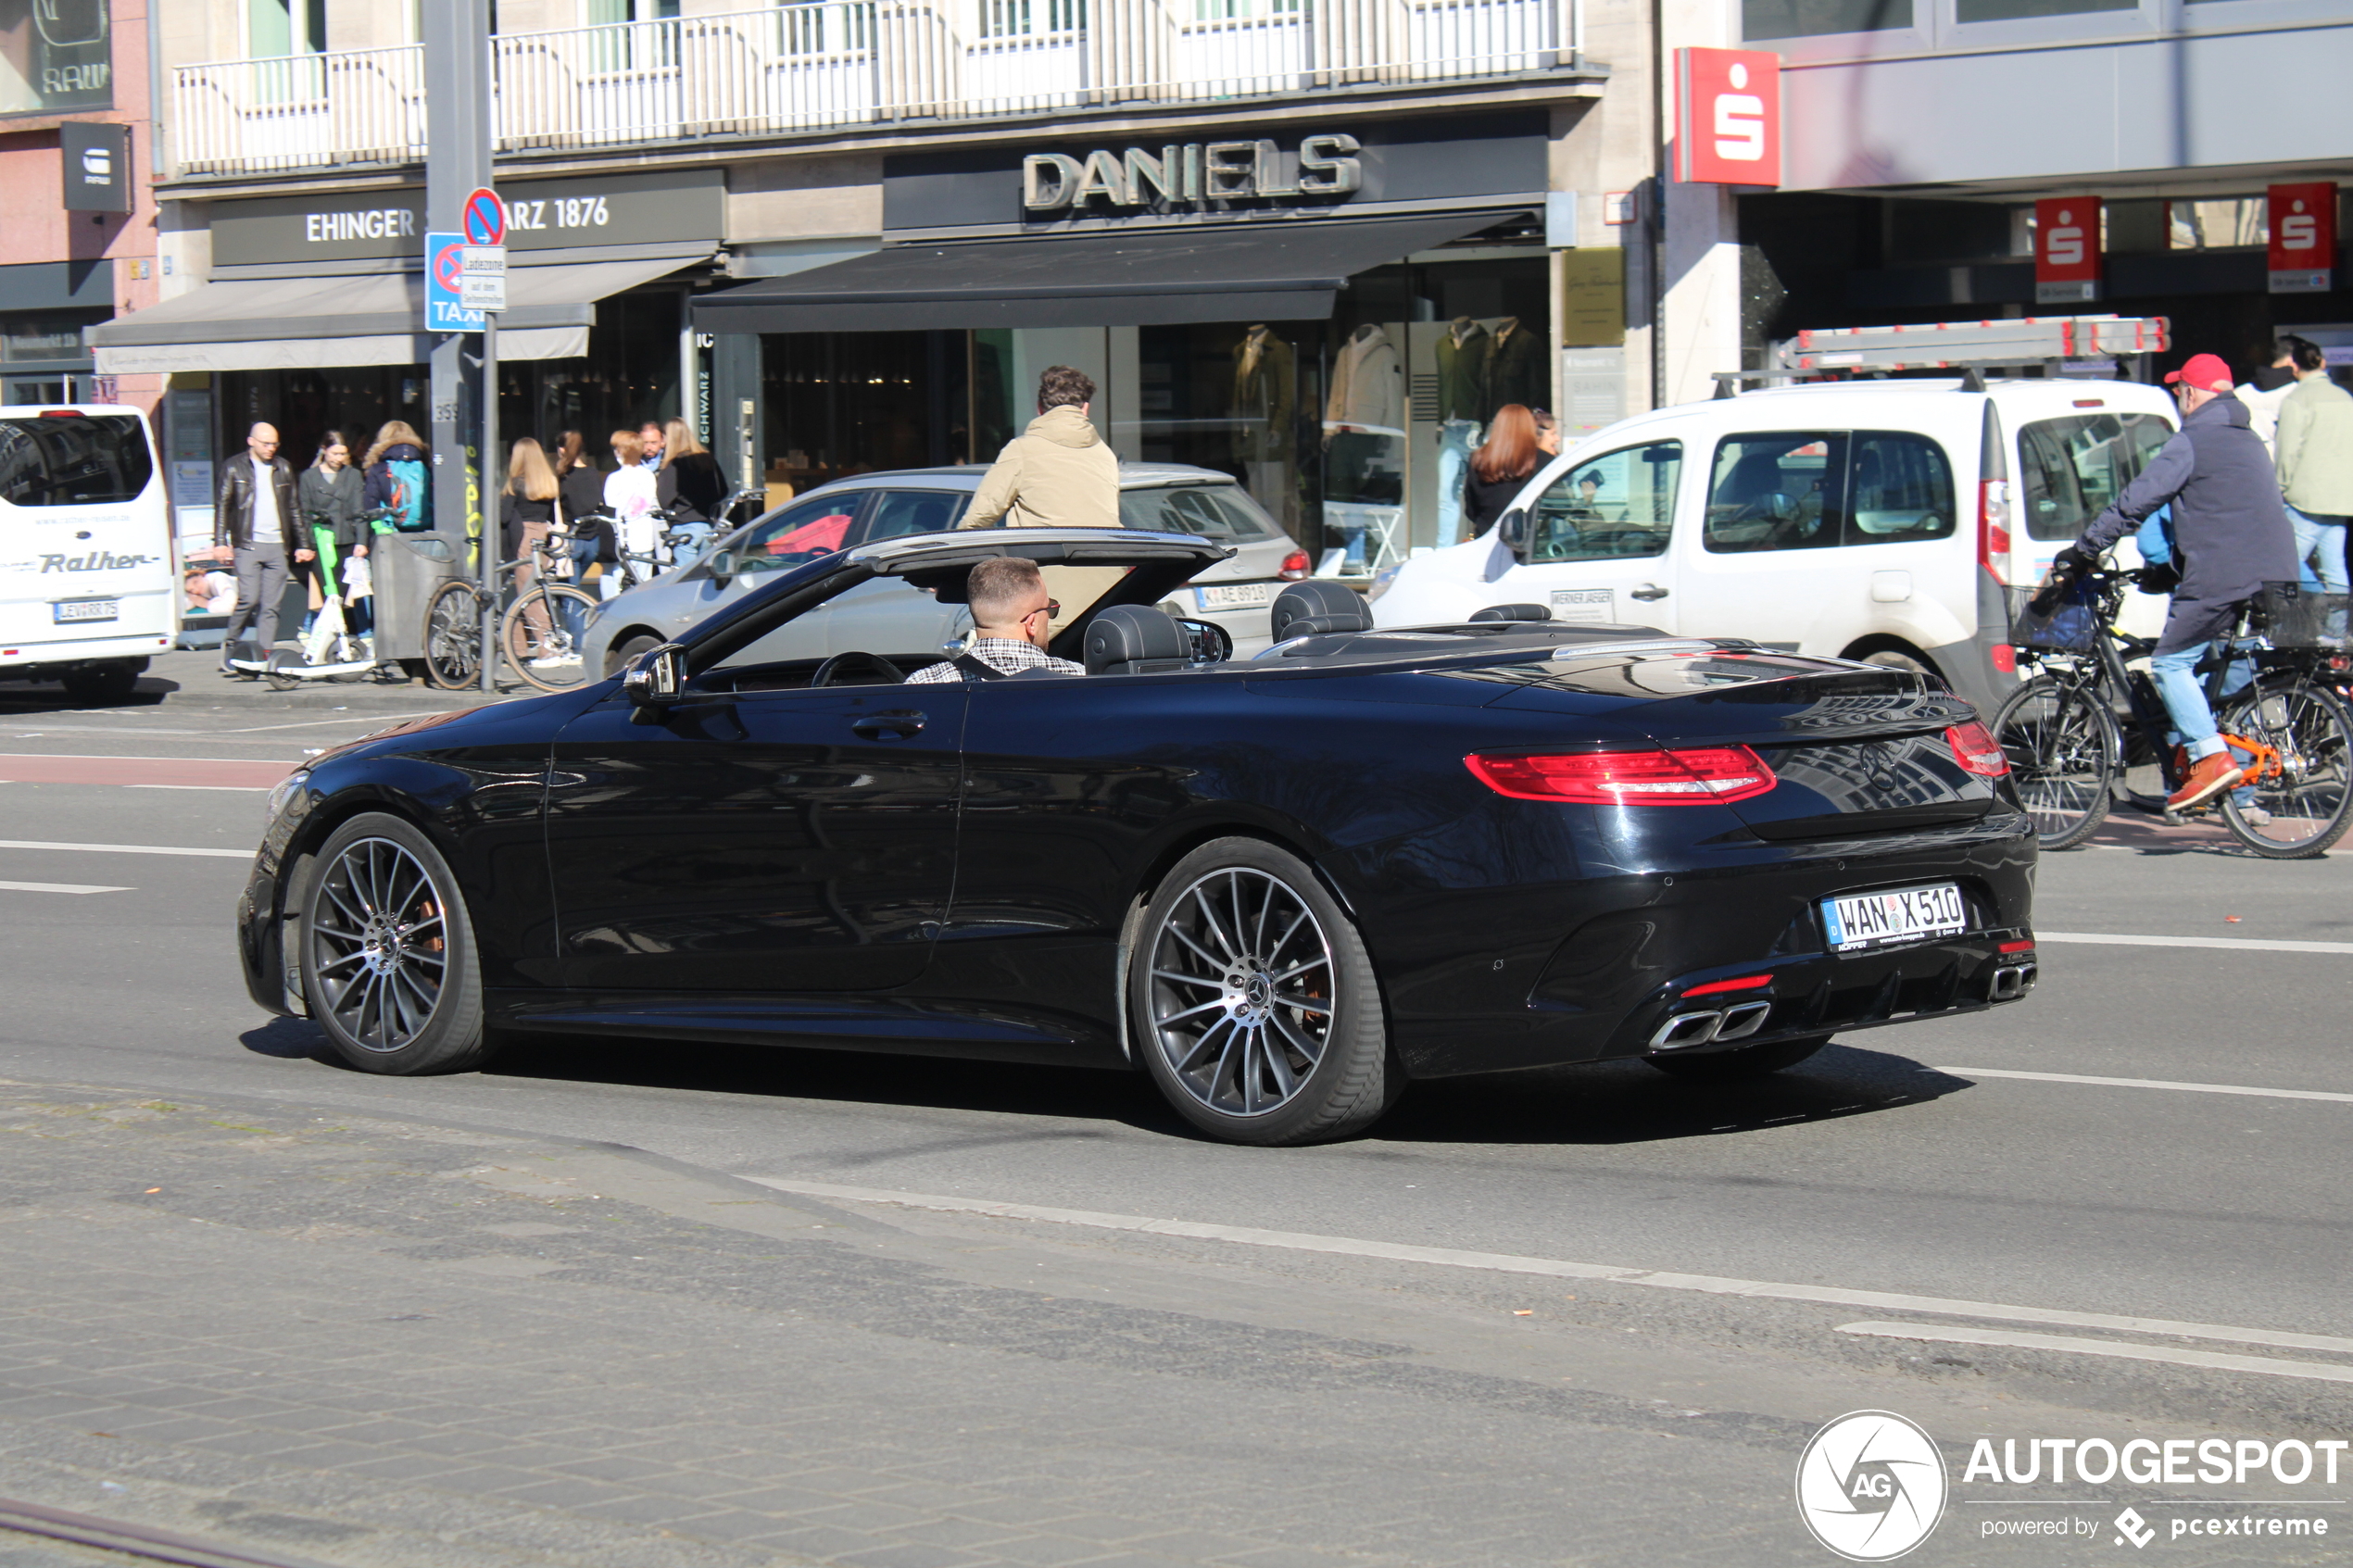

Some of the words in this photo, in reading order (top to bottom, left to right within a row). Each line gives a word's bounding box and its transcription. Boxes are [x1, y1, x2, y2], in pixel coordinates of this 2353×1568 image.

[43, 63, 110, 94] RAW
[1023, 133, 1362, 210] DANIELS
[307, 209, 415, 242] EHINGER
[554, 196, 609, 228] 1876
[464, 257, 504, 271] Ladezone
[432, 301, 485, 322] TAXI
[699, 371, 710, 444] SCHWARZ
[38, 550, 153, 574] Rather
[1221, 586, 1237, 603] AE
[60, 604, 81, 618] LEV
[1839, 897, 1890, 936] WAN
[1899, 893, 1919, 928] X
[1918, 887, 1961, 925] 510
[1831, 925, 1838, 936] D
[1838, 939, 1868, 952] KÖPPER
